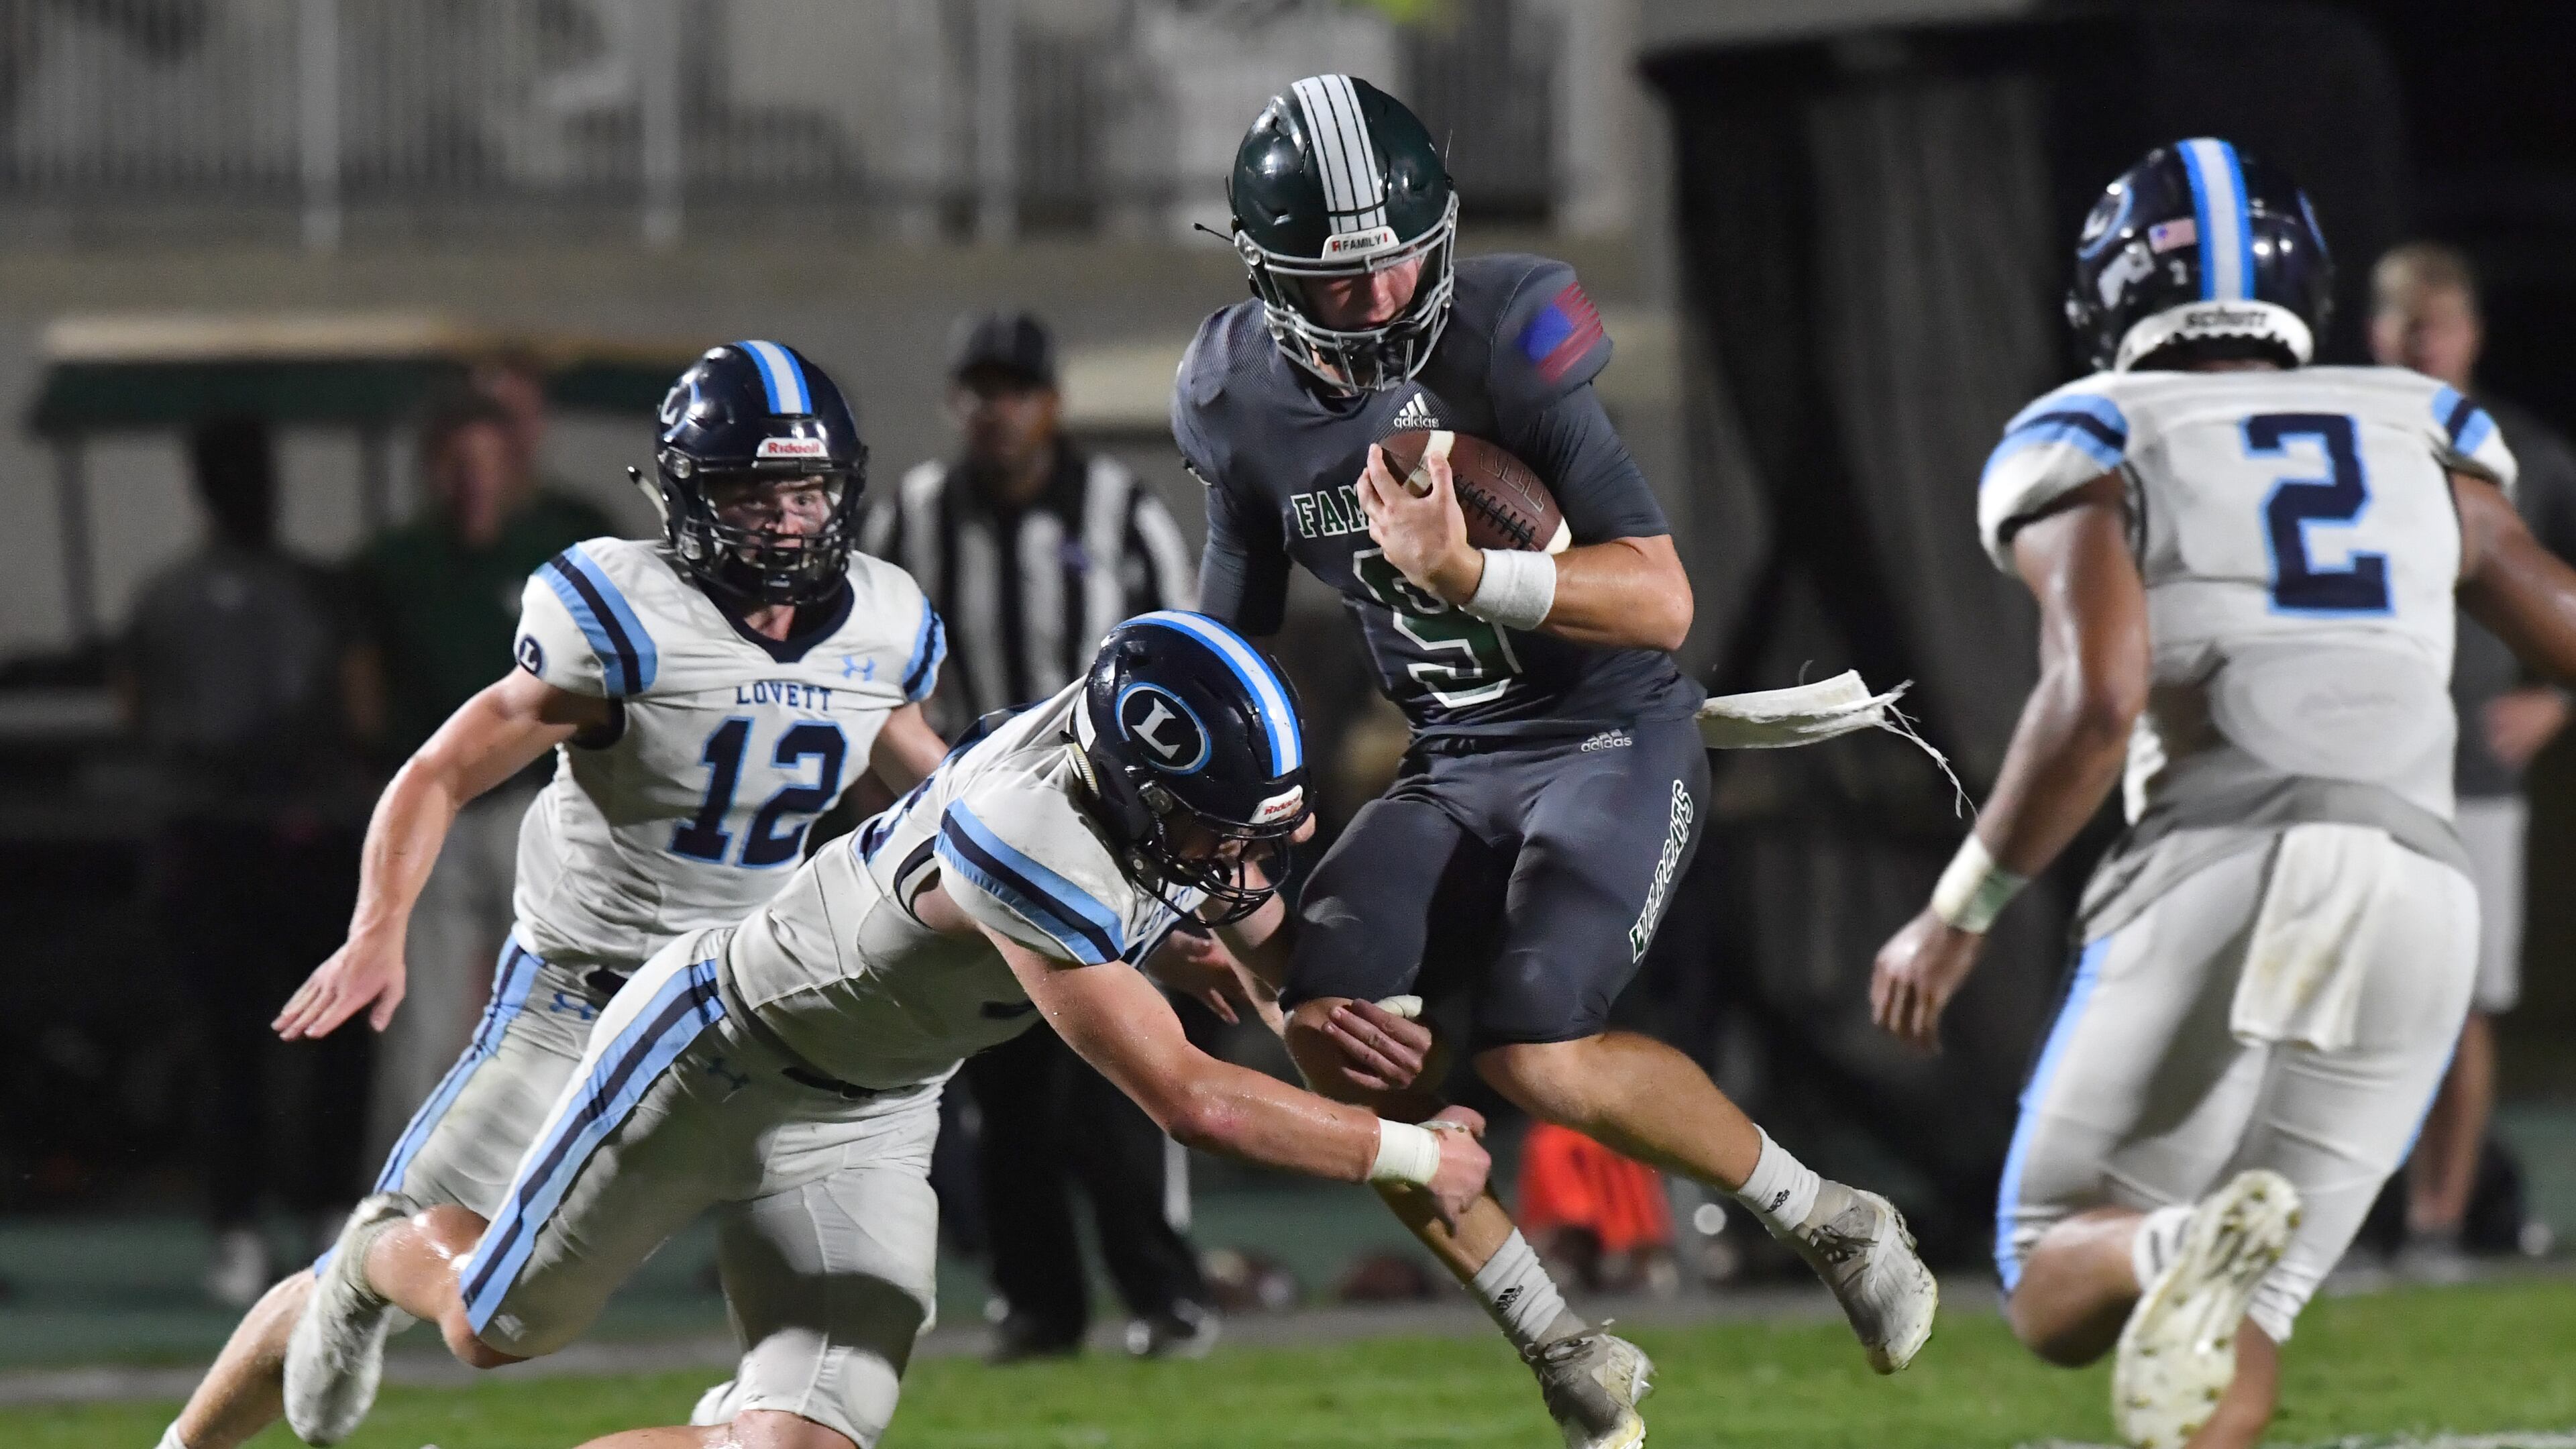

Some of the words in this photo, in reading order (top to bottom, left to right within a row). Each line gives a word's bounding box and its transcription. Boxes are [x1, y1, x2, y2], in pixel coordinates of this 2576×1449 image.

[1342, 233, 1381, 251] FAMILY
[1393, 414, 1440, 429] adidas
[2239, 412, 2396, 619] 2
[735, 680, 831, 712] LOVETT
[1130, 697, 1181, 760] L
[1580, 733, 1633, 753] adidas
[666, 715, 849, 870] 12
[1628, 779, 1694, 964] WILDCATS
